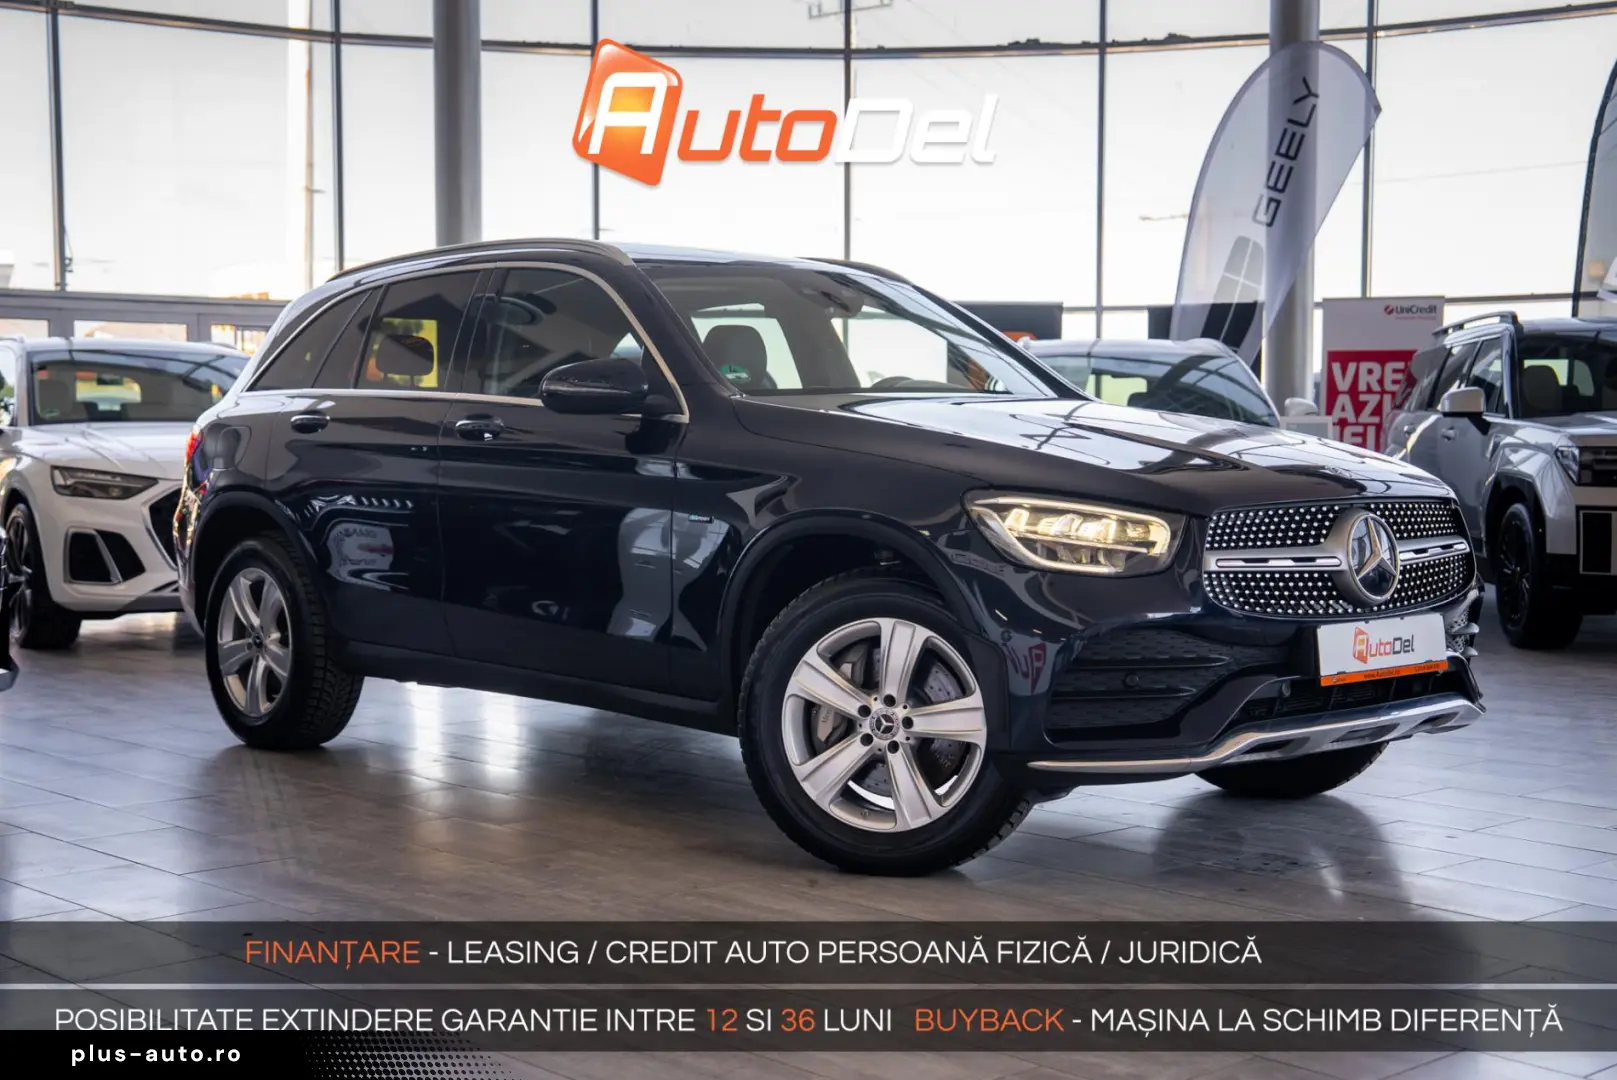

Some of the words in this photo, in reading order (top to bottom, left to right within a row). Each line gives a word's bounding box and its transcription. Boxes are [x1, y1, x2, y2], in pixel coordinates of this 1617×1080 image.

[1252, 75, 1319, 228] GEELY
[1395, 304, 1437, 315] UniCredit
[1331, 361, 1411, 392] VRE
[1331, 393, 1392, 424] AZI
[1354, 631, 1415, 660] AutoDel
